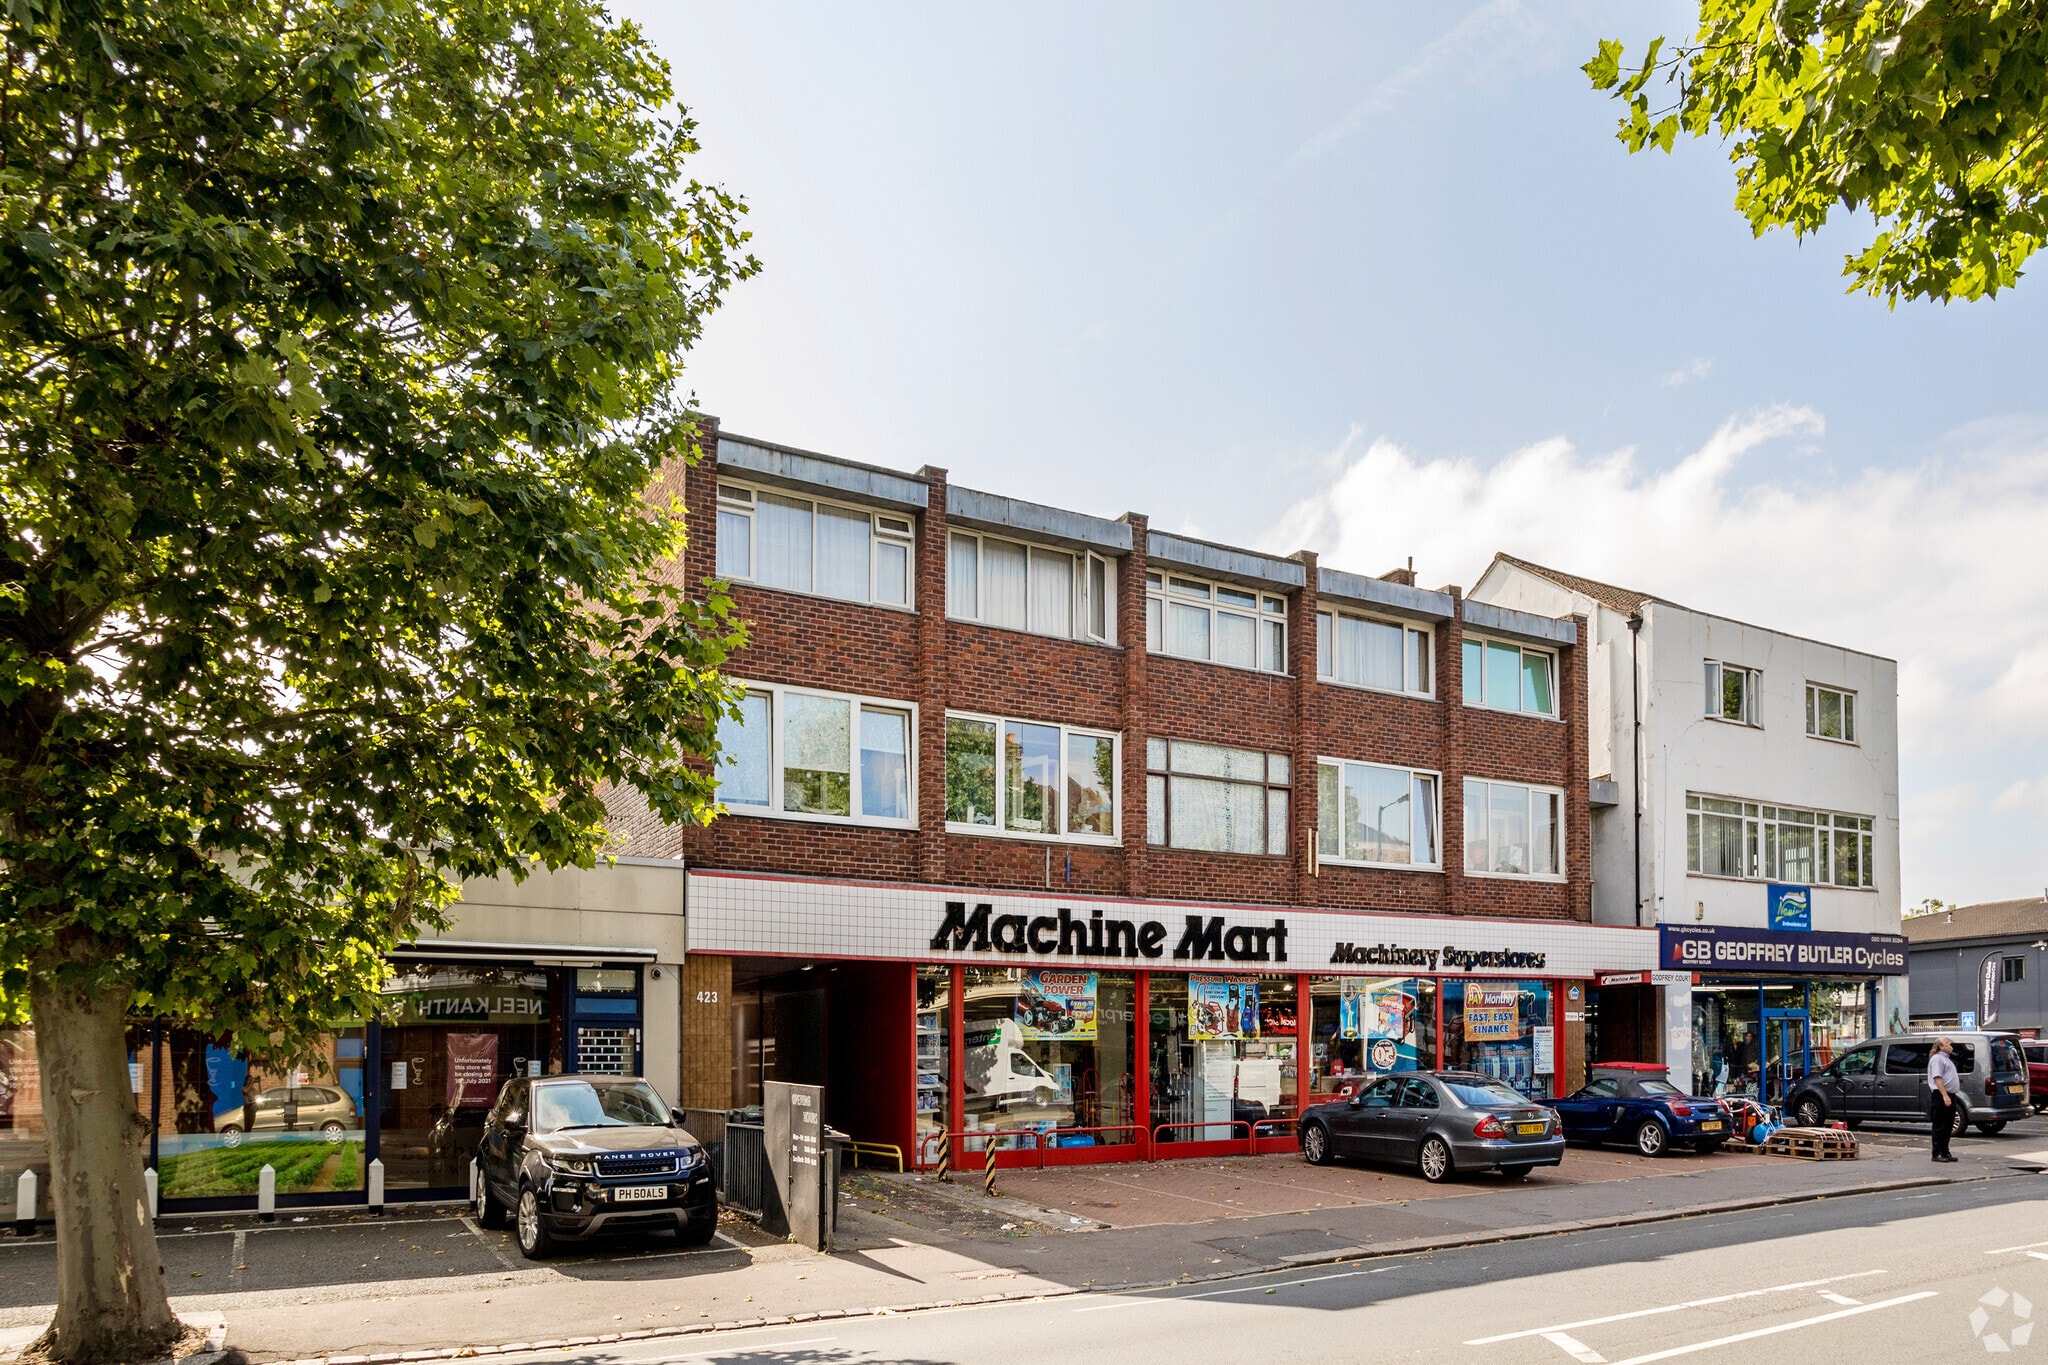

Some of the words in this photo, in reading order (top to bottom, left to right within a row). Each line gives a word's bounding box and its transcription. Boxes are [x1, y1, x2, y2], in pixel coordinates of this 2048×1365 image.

[930, 901, 1168, 959] Machine
[1173, 915, 1288, 962] Mart
[1667, 926, 1715, 934] www.gbcycles.co.uk
[1330, 942, 1440, 971] Machinery
[1442, 946, 1546, 971] Superstores
[1682, 940, 1711, 960] GB
[1715, 941, 1795, 963] GEOFFREY
[1798, 945, 1852, 964] BUTLER
[1855, 947, 1903, 969] Cycles
[1040, 971, 1088, 984] GARDEN
[1190, 975, 1223, 983] PRESSURE
[1224, 975, 1259, 984] WASHERS
[1652, 974, 1674, 982] GODFREY
[1675, 974, 1691, 982] COURT
[1044, 985, 1084, 995] POWER
[697, 991, 718, 1003] 423
[1468, 993, 1483, 1005] PAY
[1484, 993, 1516, 1006] Monthly
[1468, 1013, 1490, 1022] FAST,
[1493, 1012, 1514, 1021] EASY
[1473, 1024, 1510, 1034] FINANCE
[619, 1189, 632, 1199] PH
